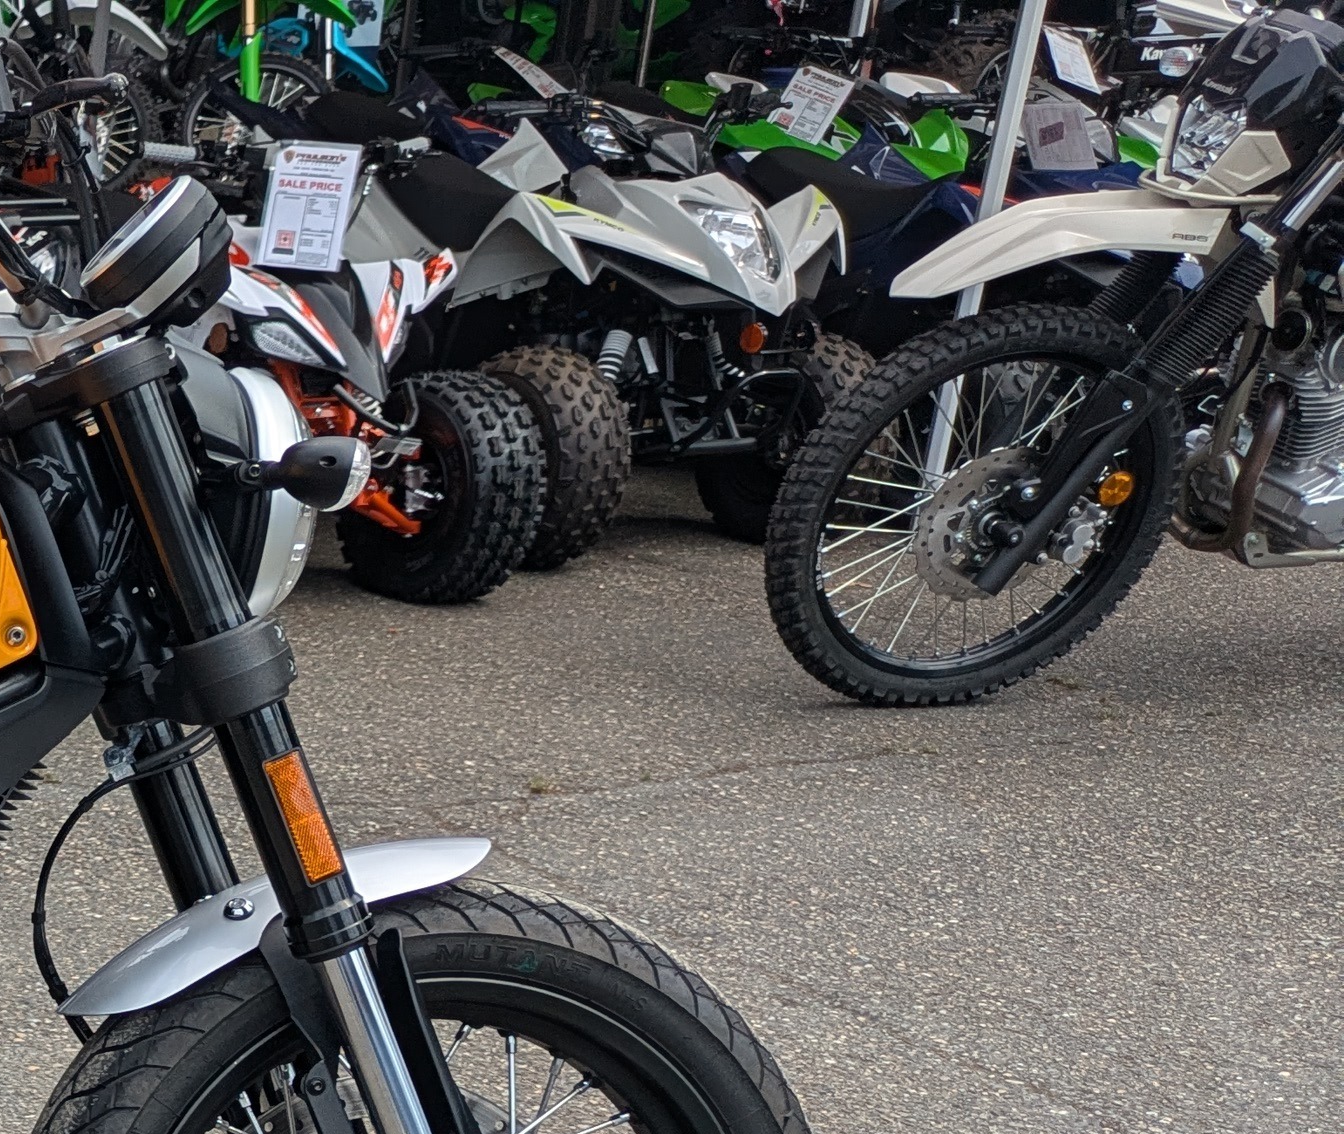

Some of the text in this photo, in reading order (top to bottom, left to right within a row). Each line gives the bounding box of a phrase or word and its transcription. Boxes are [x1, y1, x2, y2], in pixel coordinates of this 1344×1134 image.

[1201, 78, 1237, 96] Kawasaki
[278, 178, 343, 193] SALE PRICE
[1171, 233, 1209, 243] ABS
